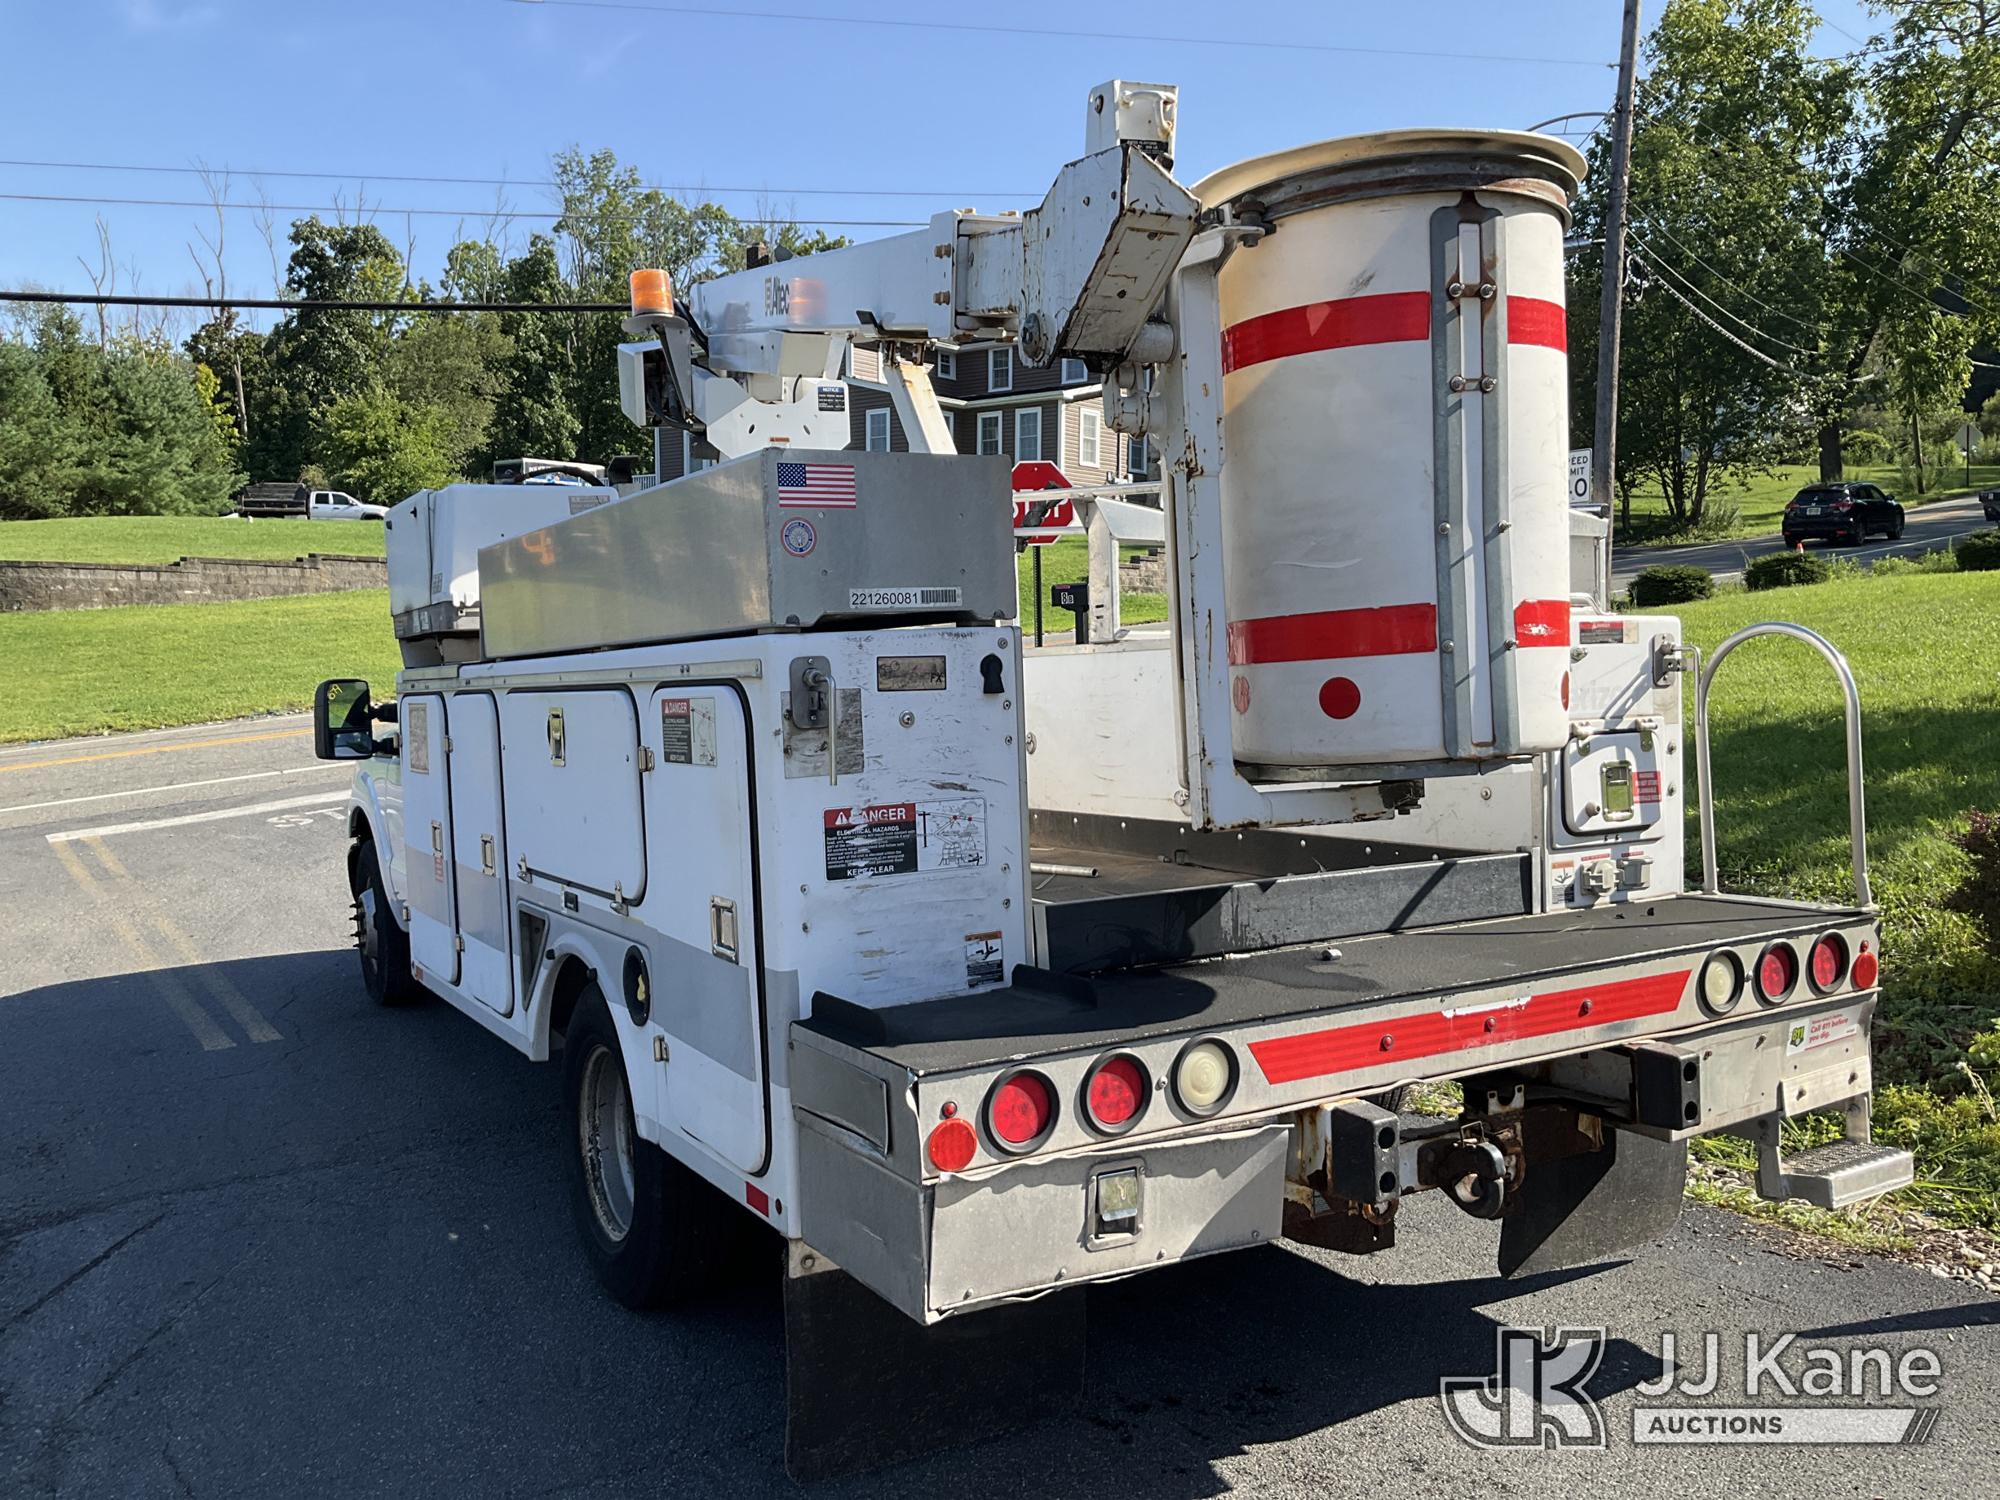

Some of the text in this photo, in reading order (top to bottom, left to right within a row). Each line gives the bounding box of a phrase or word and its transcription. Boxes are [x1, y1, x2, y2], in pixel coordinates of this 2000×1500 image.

[1569, 456, 1588, 465] EED
[1570, 478, 1587, 497] 0
[851, 592, 918, 605] 221260081
[669, 702, 688, 713] DANGER
[851, 807, 906, 824] ANGER
